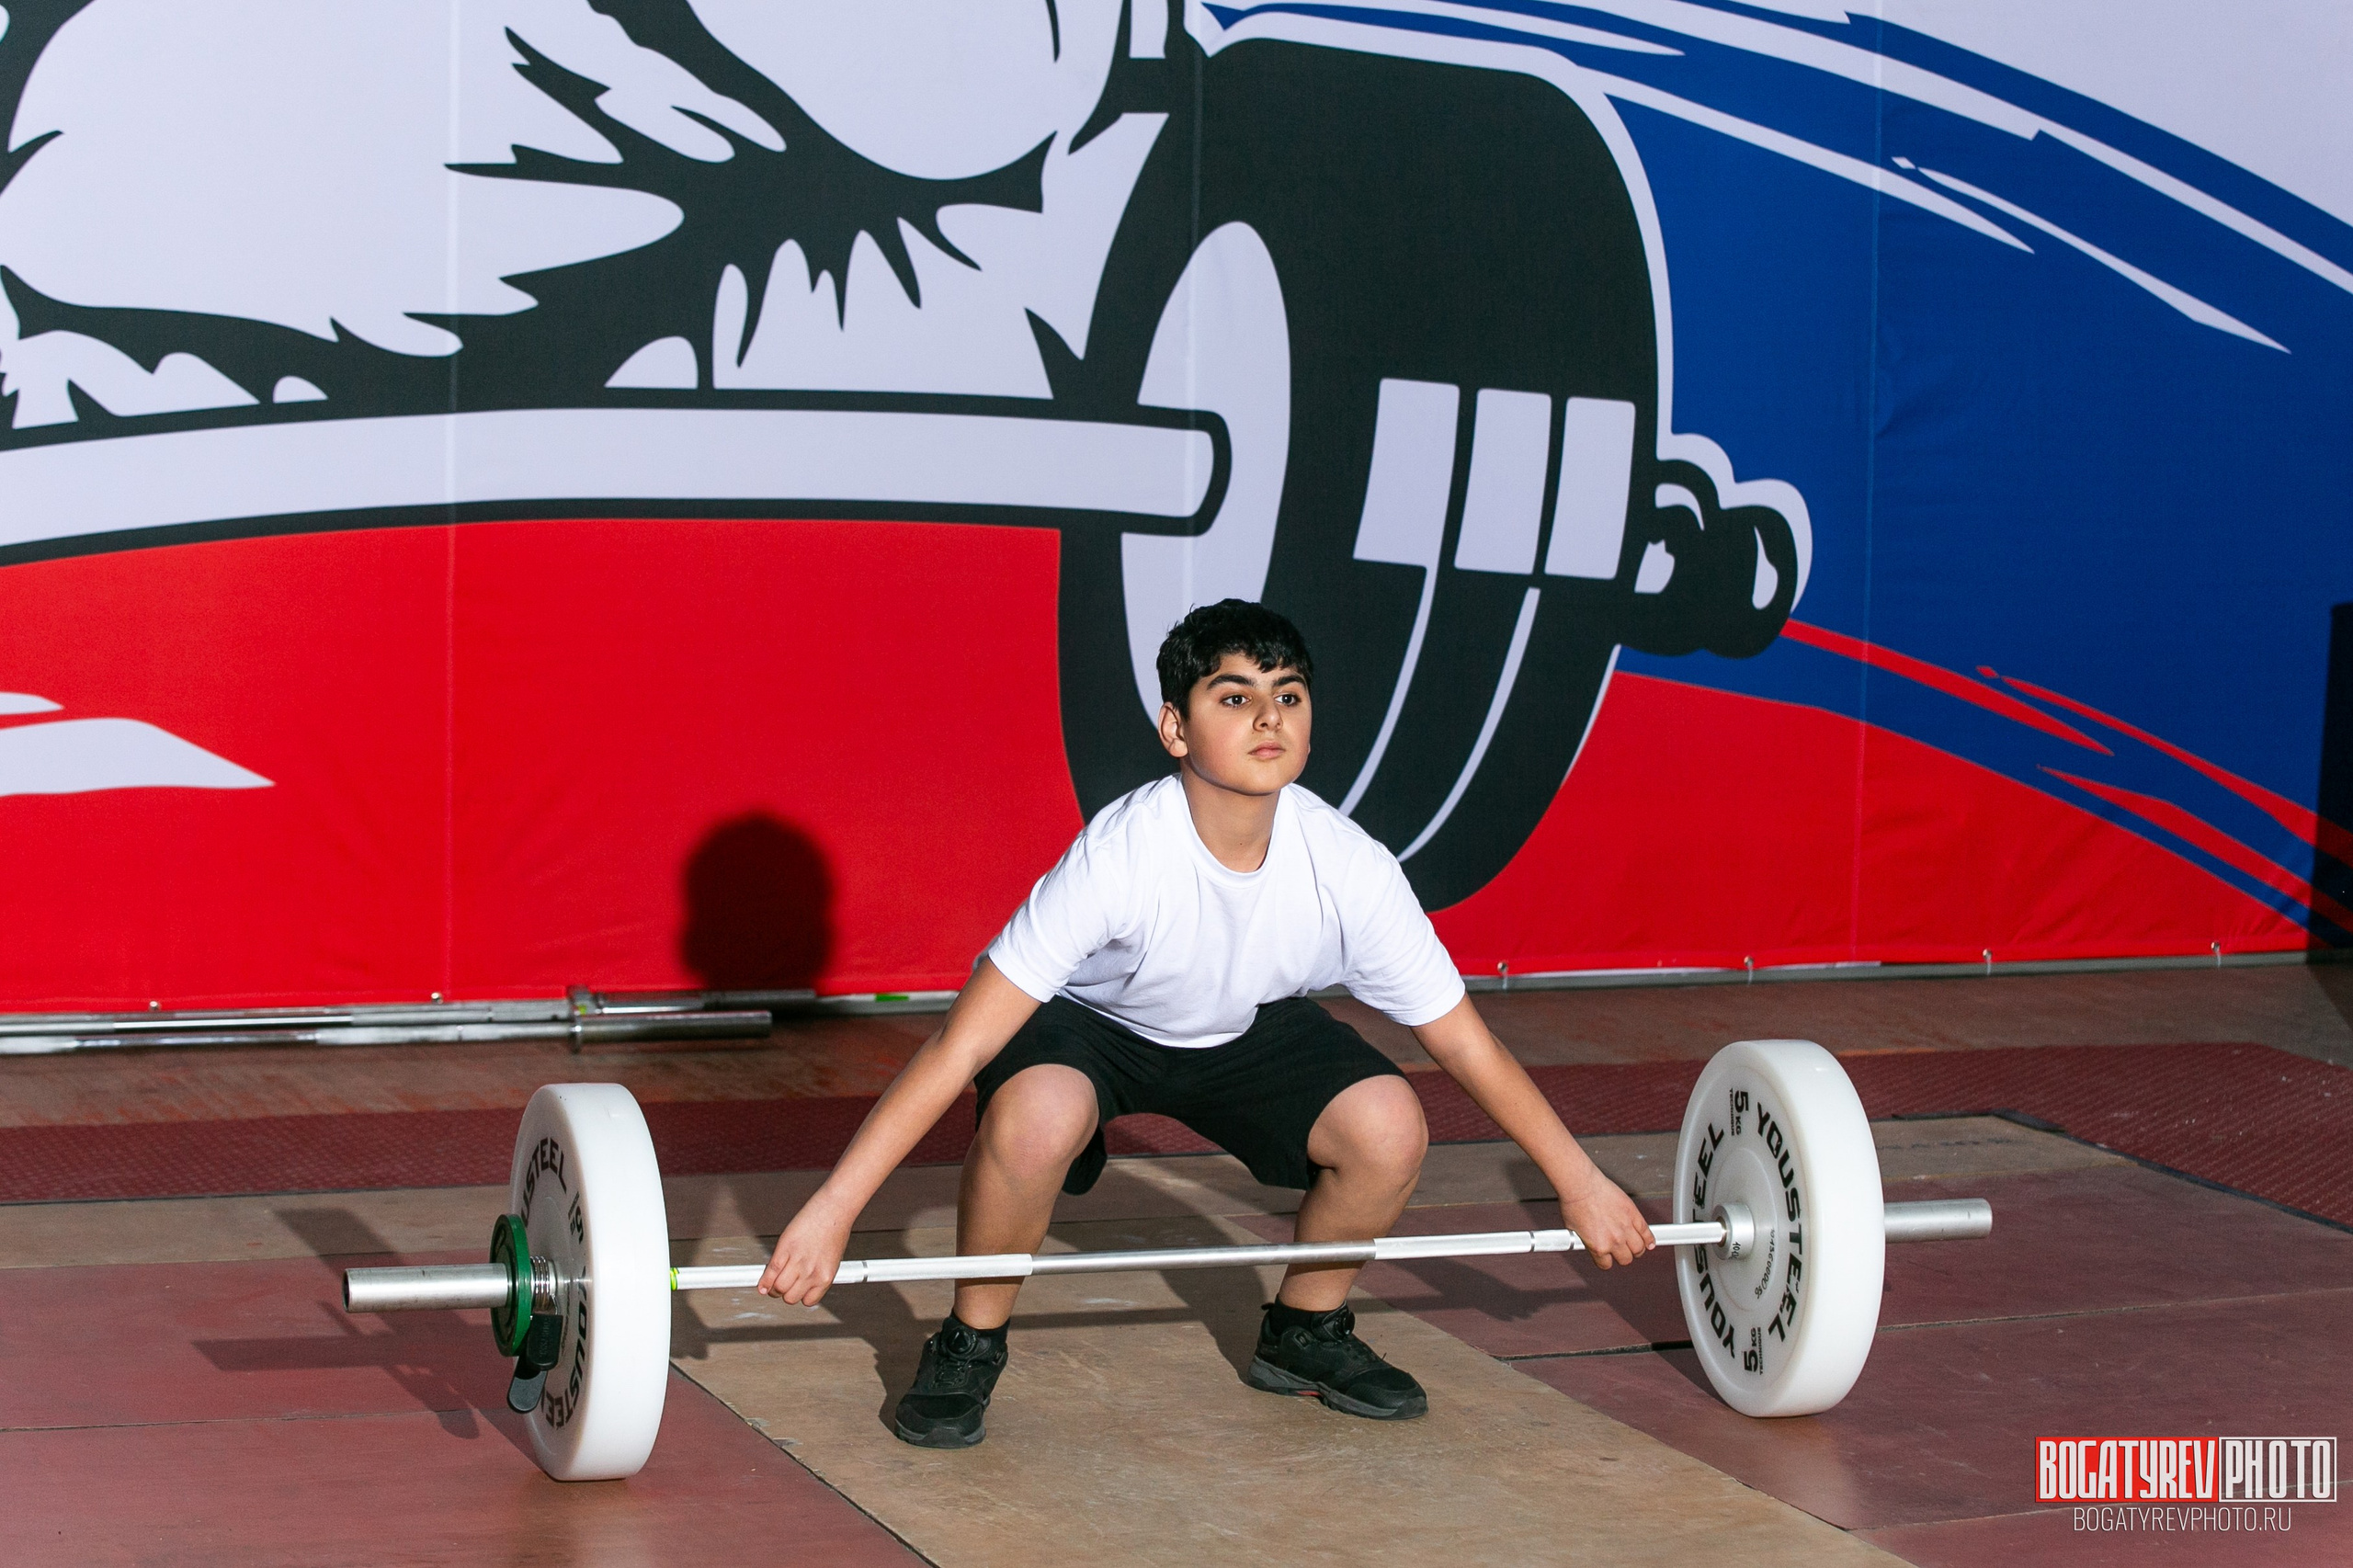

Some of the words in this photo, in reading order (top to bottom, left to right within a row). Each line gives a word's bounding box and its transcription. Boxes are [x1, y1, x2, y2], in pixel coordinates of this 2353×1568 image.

[1735, 1116, 1742, 1135] KG
[520, 1136, 567, 1229] USTEEL
[1757, 1101, 1802, 1343] YOUSTEEL
[1750, 1327, 1756, 1346] KG
